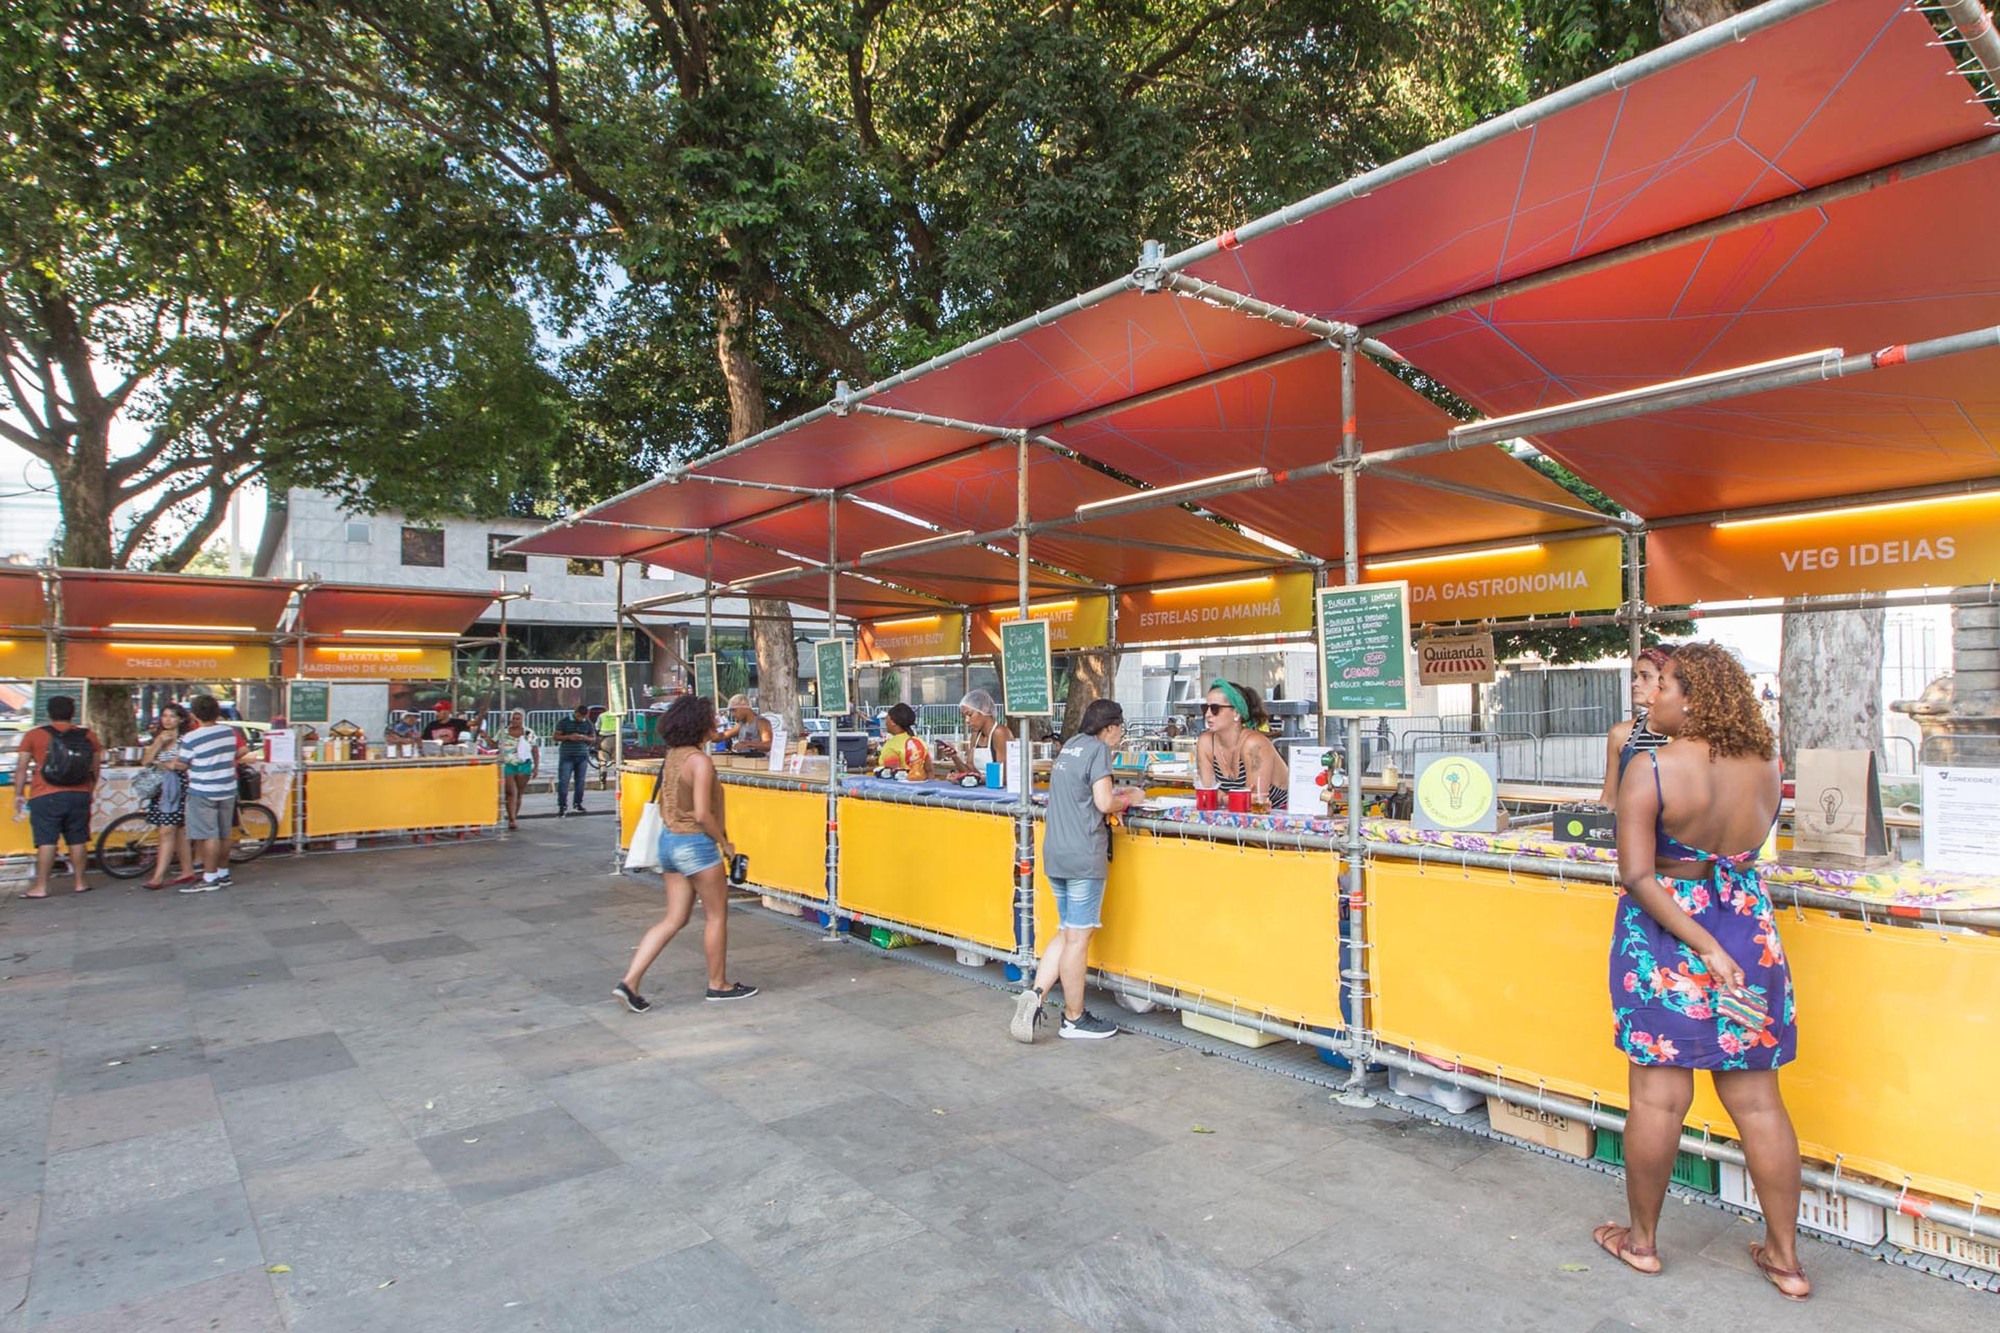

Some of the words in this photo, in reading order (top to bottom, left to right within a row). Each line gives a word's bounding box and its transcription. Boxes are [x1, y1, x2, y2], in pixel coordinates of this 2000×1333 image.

[1779, 546, 1840, 572] VEG
[1849, 536, 1956, 567] IDEIAS
[1441, 569, 1589, 601] GASTRONOMIA
[1140, 608, 1199, 627] ESTRELAS
[1201, 606, 1219, 621] DO
[1222, 597, 1281, 620] AMANHÃ
[338, 652, 380, 662] BATATA
[382, 652, 399, 662] DO
[1423, 643, 1486, 662] Quitanda
[126, 657, 172, 668] CHEGA
[175, 658, 218, 669] JUNTO
[362, 664, 377, 673] DE
[506, 666, 520, 675] DE
[520, 665, 583, 676] CONVENÇÕES
[528, 676, 551, 689] do
[553, 676, 583, 689] RIO
